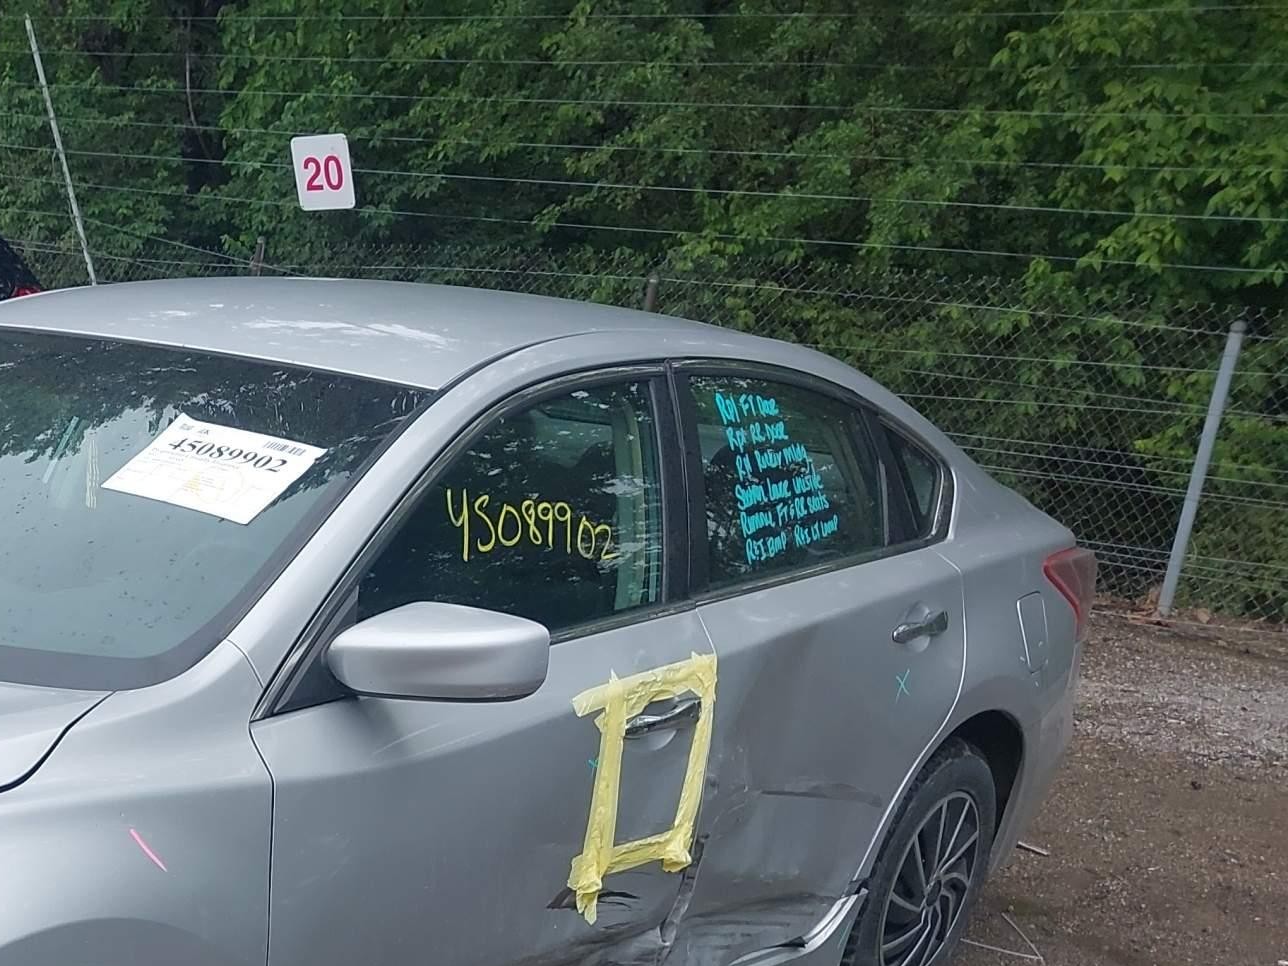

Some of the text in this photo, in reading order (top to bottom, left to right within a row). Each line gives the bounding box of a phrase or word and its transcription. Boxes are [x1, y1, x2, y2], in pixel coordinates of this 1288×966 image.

[303, 155, 344, 191] 20
[167, 437, 288, 473] 45089902
[446, 487, 621, 563] 45089902
